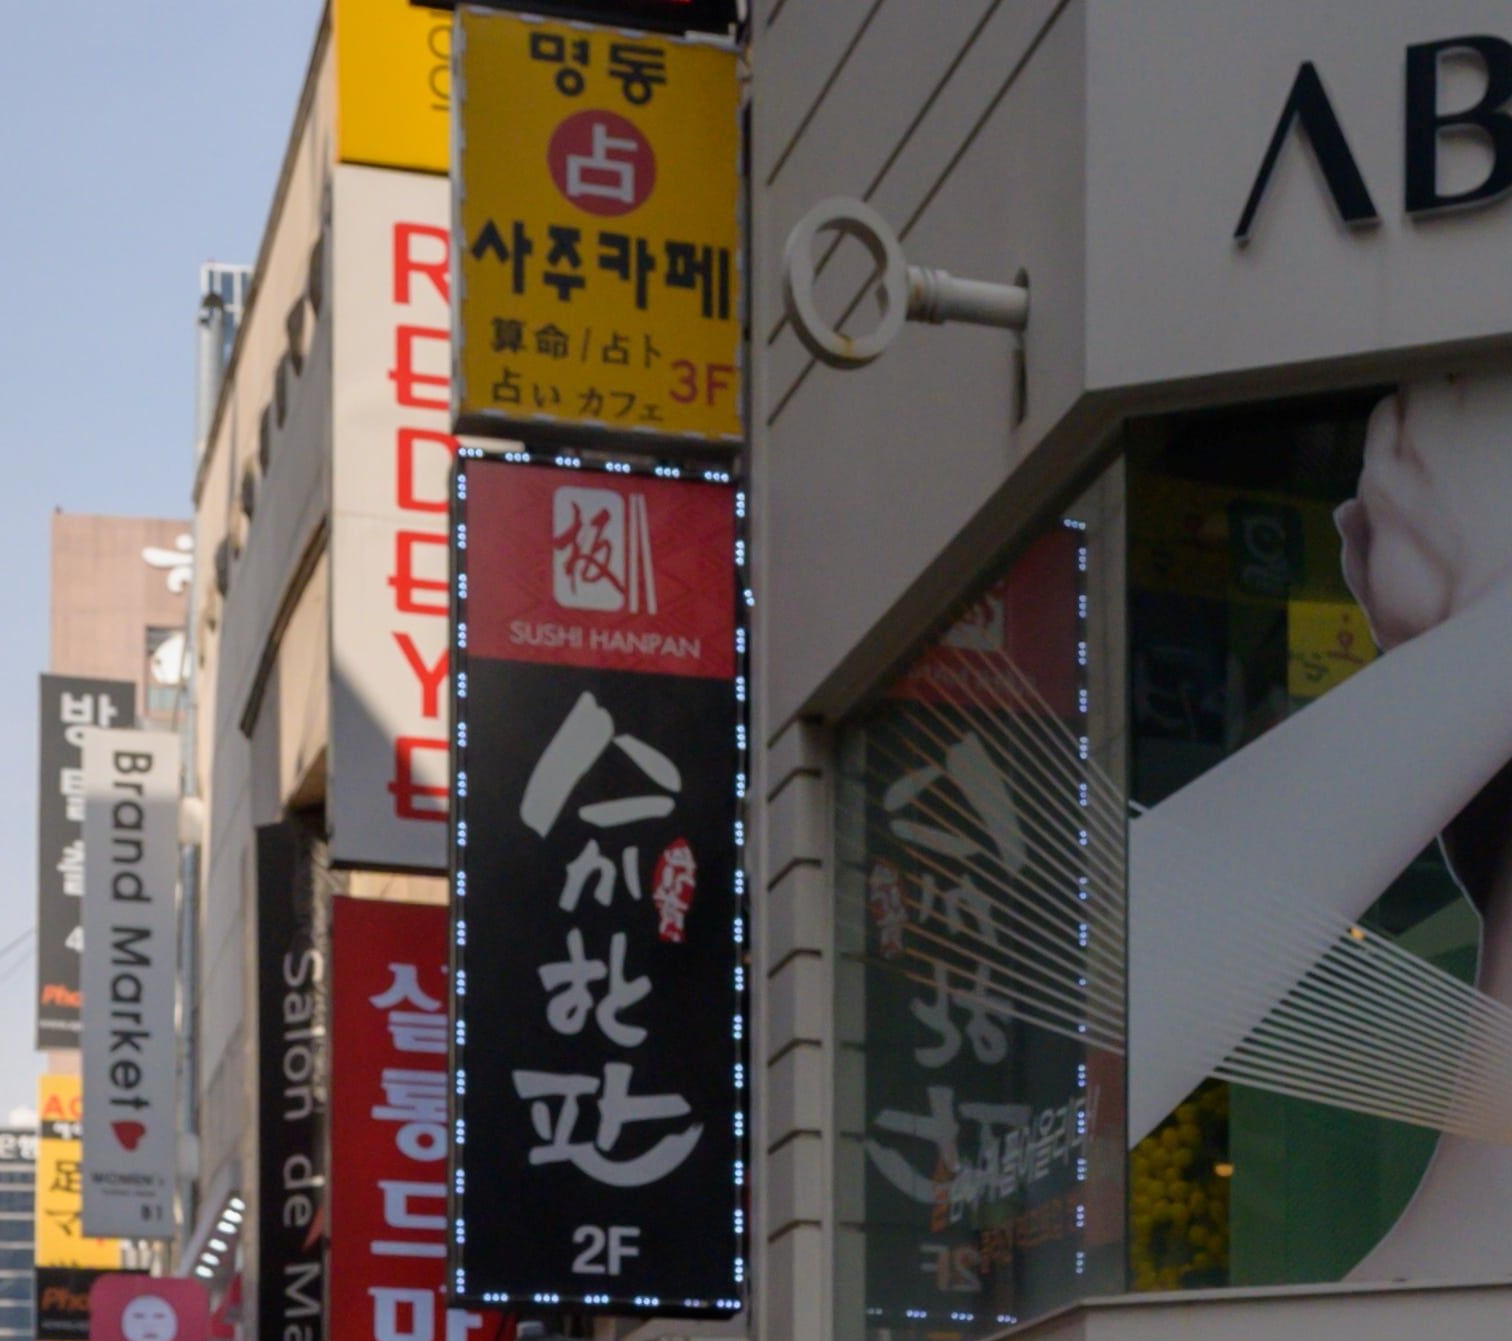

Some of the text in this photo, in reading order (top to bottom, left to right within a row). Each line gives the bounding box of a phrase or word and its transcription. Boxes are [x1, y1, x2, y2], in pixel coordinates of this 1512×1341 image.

[530, 31, 668, 105] 명동
[472, 219, 733, 321] 사주카페
[669, 360, 735, 407] 3F
[510, 620, 702, 660] SUSHI HANPAN
[109, 750, 153, 1112] Brand Market
[283, 949, 323, 1121] Salon
[282, 1151, 323, 1234] de
[572, 1225, 641, 1276] 2F
